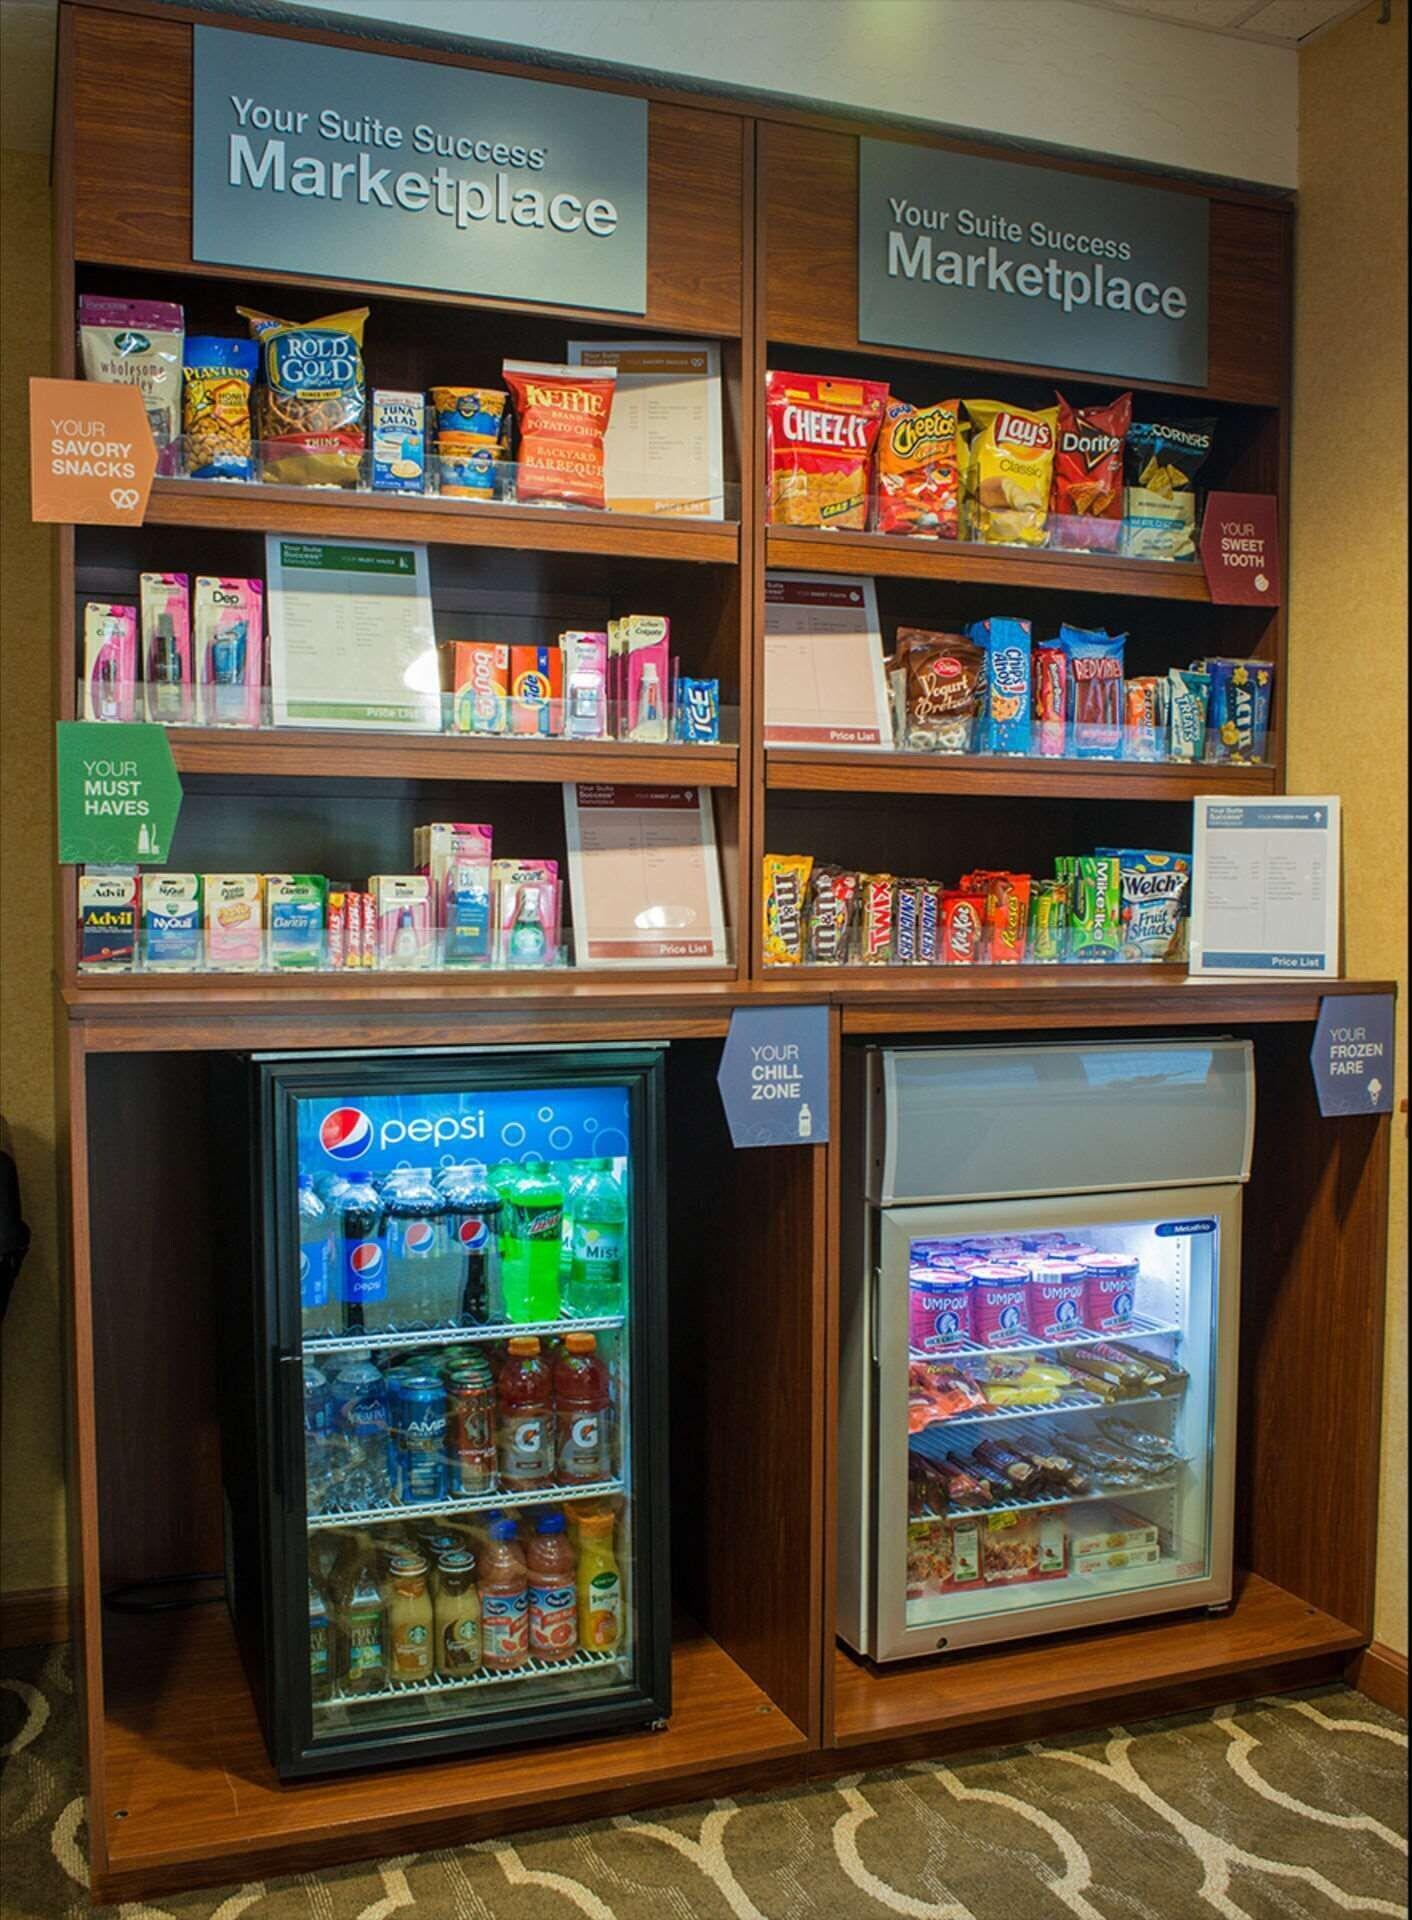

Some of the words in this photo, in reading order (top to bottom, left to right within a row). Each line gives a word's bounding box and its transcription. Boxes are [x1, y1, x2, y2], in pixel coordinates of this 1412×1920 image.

[230, 95, 308, 133] Your
[318, 109, 403, 150] Suite
[413, 125, 545, 171] Success
[228, 133, 618, 238] Marketplace
[889, 197, 949, 231] Your
[957, 208, 1022, 242] Suite
[1030, 221, 1131, 262] Success
[887, 230, 1188, 320] Marketplace
[287, 336, 350, 359] ROLD
[100, 359, 165, 375] wholesome
[281, 358, 353, 383] GOLD
[525, 383, 606, 417] KETTLE
[383, 405, 414, 418] TUNA
[50, 419, 106, 437] YOUR
[379, 415, 417, 428] SALAD
[527, 419, 572, 431] POTATO
[783, 405, 869, 448] CHEEZ-IT
[998, 413, 1051, 447] Lay's
[304, 436, 340, 448] THINS
[893, 409, 956, 458] Cheetos
[51, 439, 132, 459] SAVORY
[51, 459, 136, 479] SNACKS
[999, 458, 1042, 478] Classic
[1220, 522, 1254, 537] YOUR
[1221, 537, 1265, 554] SWEET
[1222, 553, 1265, 568] TOOTH
[212, 590, 240, 606] Dep
[687, 687, 713, 733] ICE
[1235, 687, 1252, 729] ACT
[1175, 695, 1194, 743] TREATS
[829, 730, 855, 742] Price
[856, 731, 875, 742] List
[83, 760, 137, 777] YOUR
[84, 780, 142, 797] MUST
[85, 800, 149, 816] HAVES
[93, 888, 125, 898] Advil
[85, 911, 132, 926] Advil
[153, 917, 193, 930] NyQuil
[900, 893, 915, 959] SNICKERS
[922, 894, 937, 960] SNICKERS
[1138, 910, 1169, 929] Fruit
[659, 944, 686, 956] Price
[1272, 956, 1298, 968] Price
[1299, 957, 1320, 968] List
[1330, 1028, 1366, 1041] YOUR
[750, 1045, 800, 1062] YOUR
[1330, 1043, 1384, 1058] FROZEN
[751, 1063, 803, 1081] CHILL
[1330, 1060, 1364, 1076] FARE
[751, 1081, 800, 1100] ZONE
[380, 1110, 486, 1151] pepsi
[586, 1245, 619, 1259] Mist
[353, 1281, 381, 1293] pepsi
[407, 1418, 446, 1432] AMP
[572, 1417, 598, 1448] G
[515, 1422, 541, 1453] G
